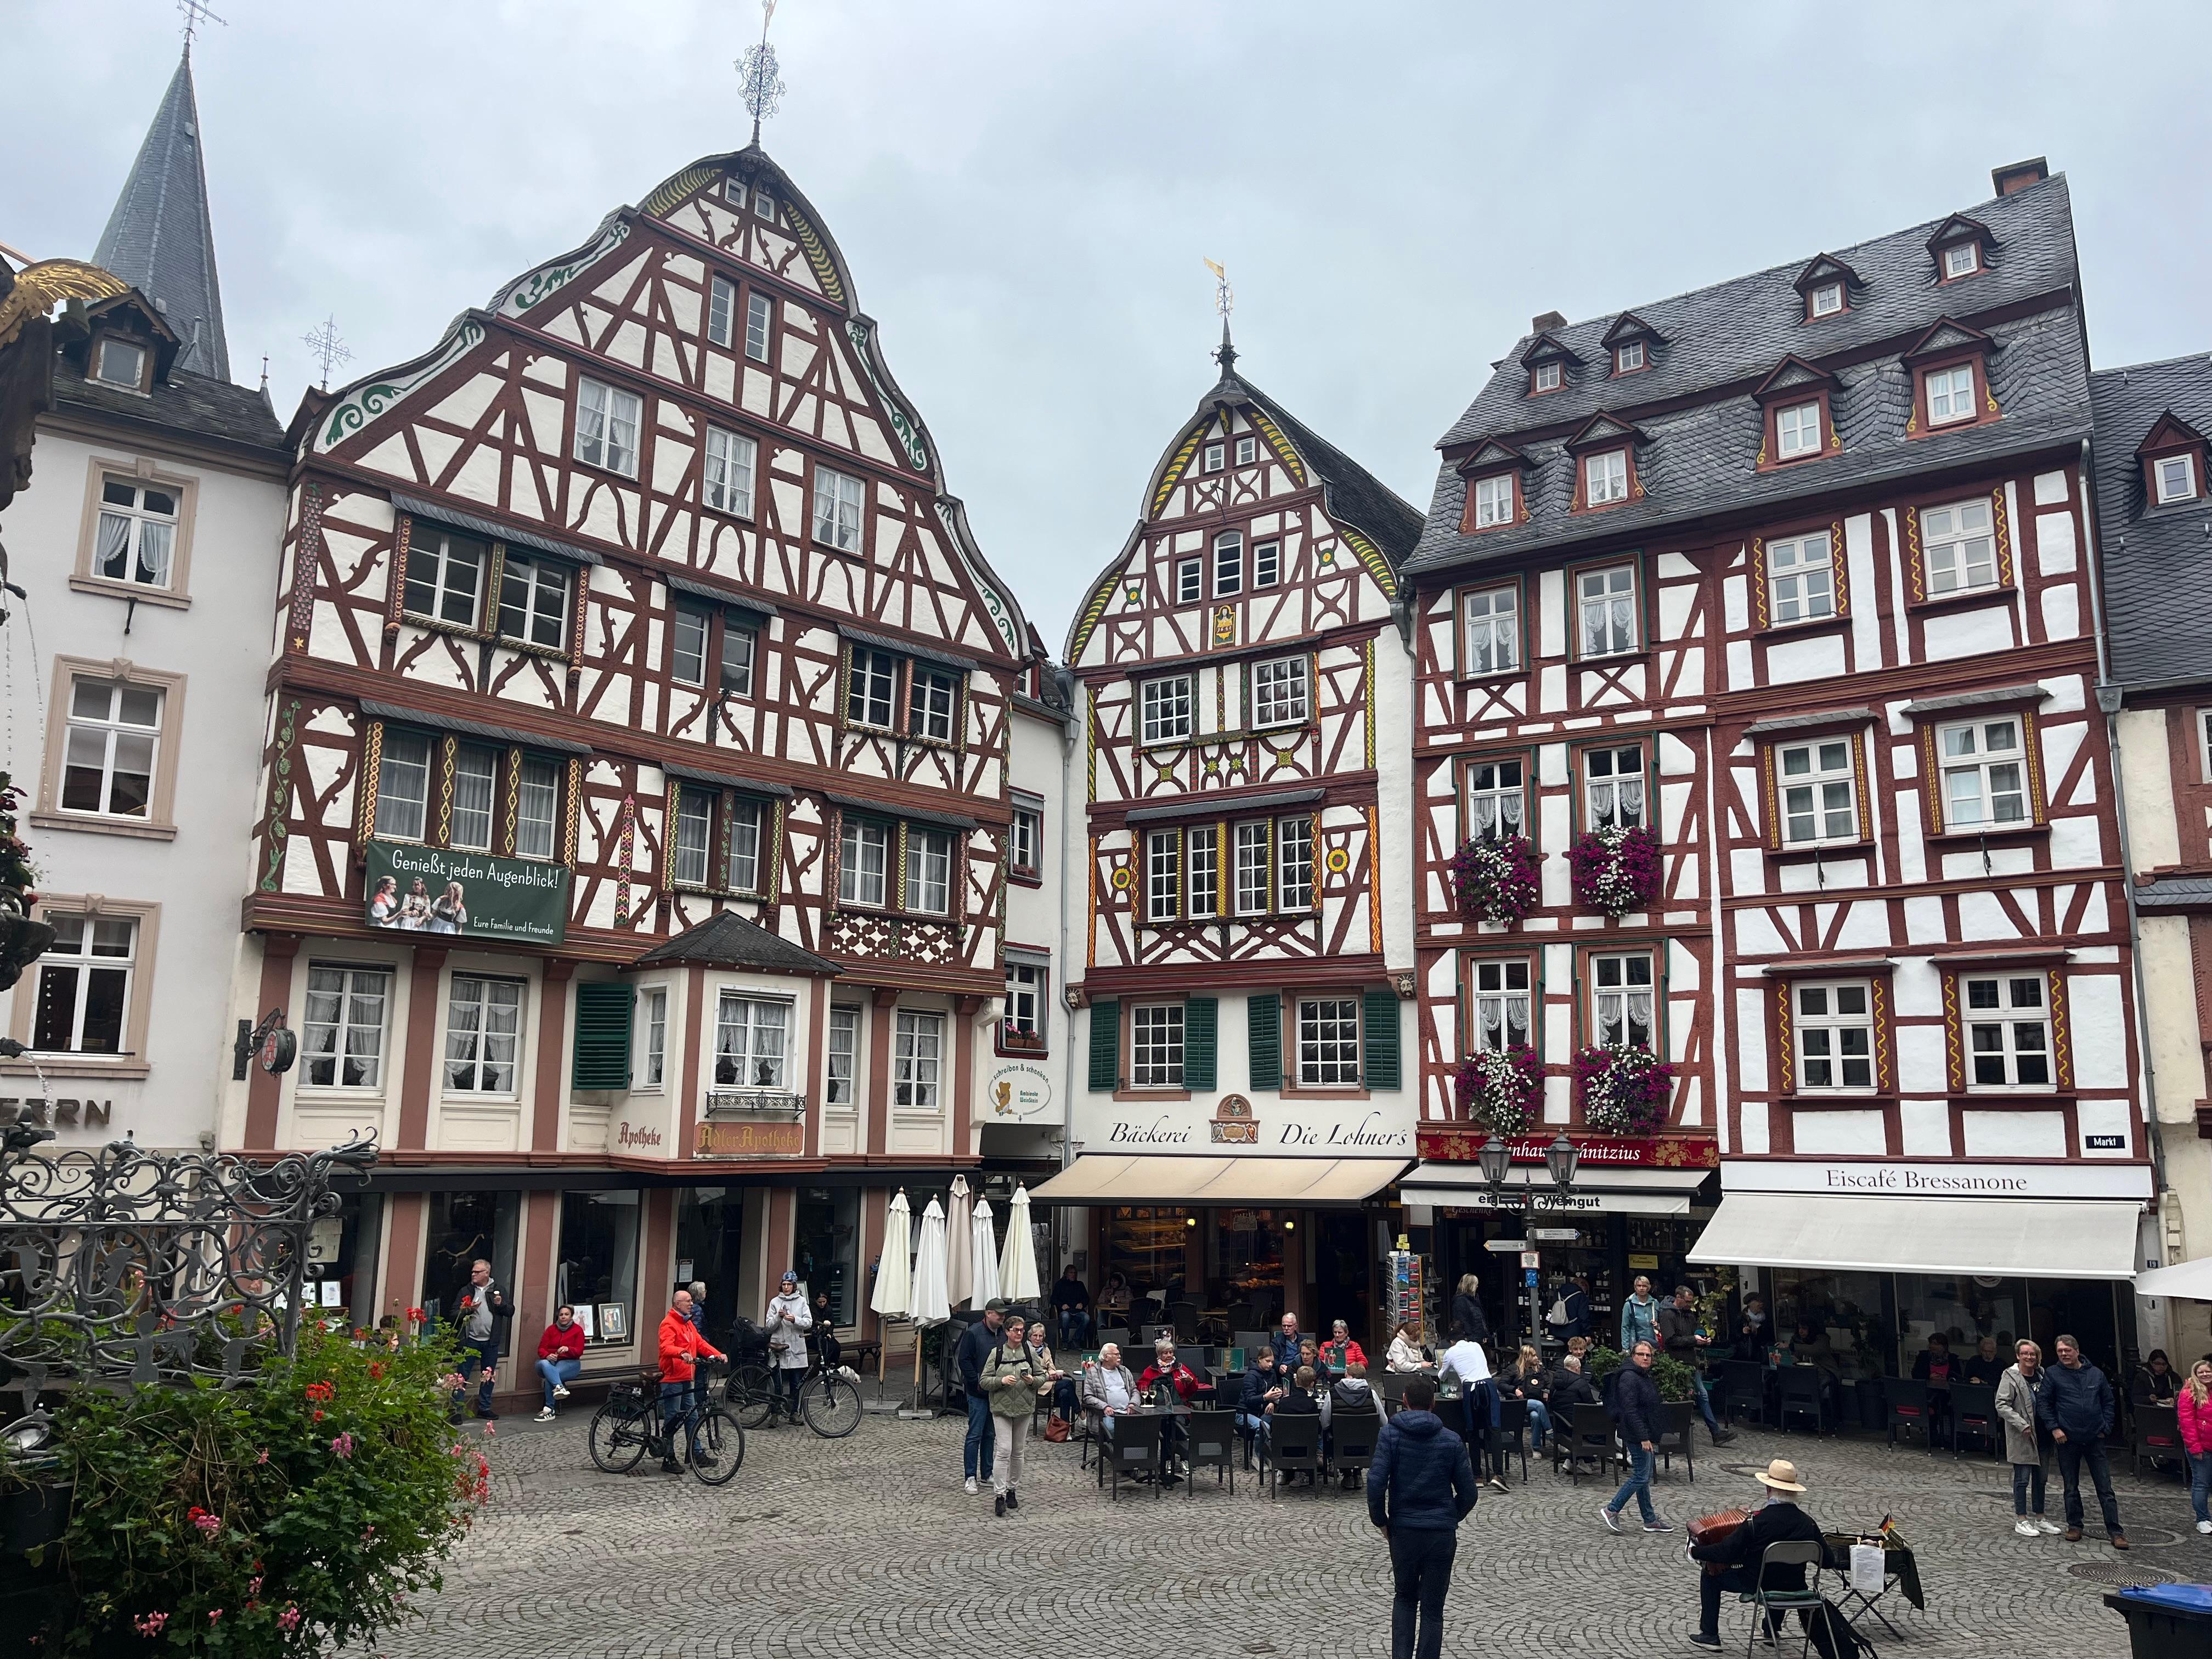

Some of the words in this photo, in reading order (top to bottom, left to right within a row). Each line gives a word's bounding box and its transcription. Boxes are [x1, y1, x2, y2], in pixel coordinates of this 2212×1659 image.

[392, 849, 445, 875] Genießt
[446, 857, 483, 881] jeden
[487, 862, 558, 889] Augenblick!
[473, 917, 489, 929] Eure
[490, 918, 514, 931] Familie
[515, 922, 527, 932] und
[528, 922, 554, 935] Freunde
[993, 1064, 1019, 1080] schreiben
[1026, 1066, 1049, 1084] schenken
[618, 1121, 661, 1149] Apotheke
[697, 1124, 741, 1149] Adler
[740, 1126, 800, 1152] Apotheke
[1108, 1115, 1192, 1143] Bäckerei
[1279, 1124, 1319, 1145] Die
[1324, 1111, 1408, 1146] Lohner's
[1576, 1142, 1641, 1160] hnitzius
[2094, 1137, 2116, 1146] Markt
[1826, 1169, 1897, 1188] Eiscafé
[1904, 1171, 2028, 1190] Bressanone
[1543, 1195, 1600, 1209] Wengut
